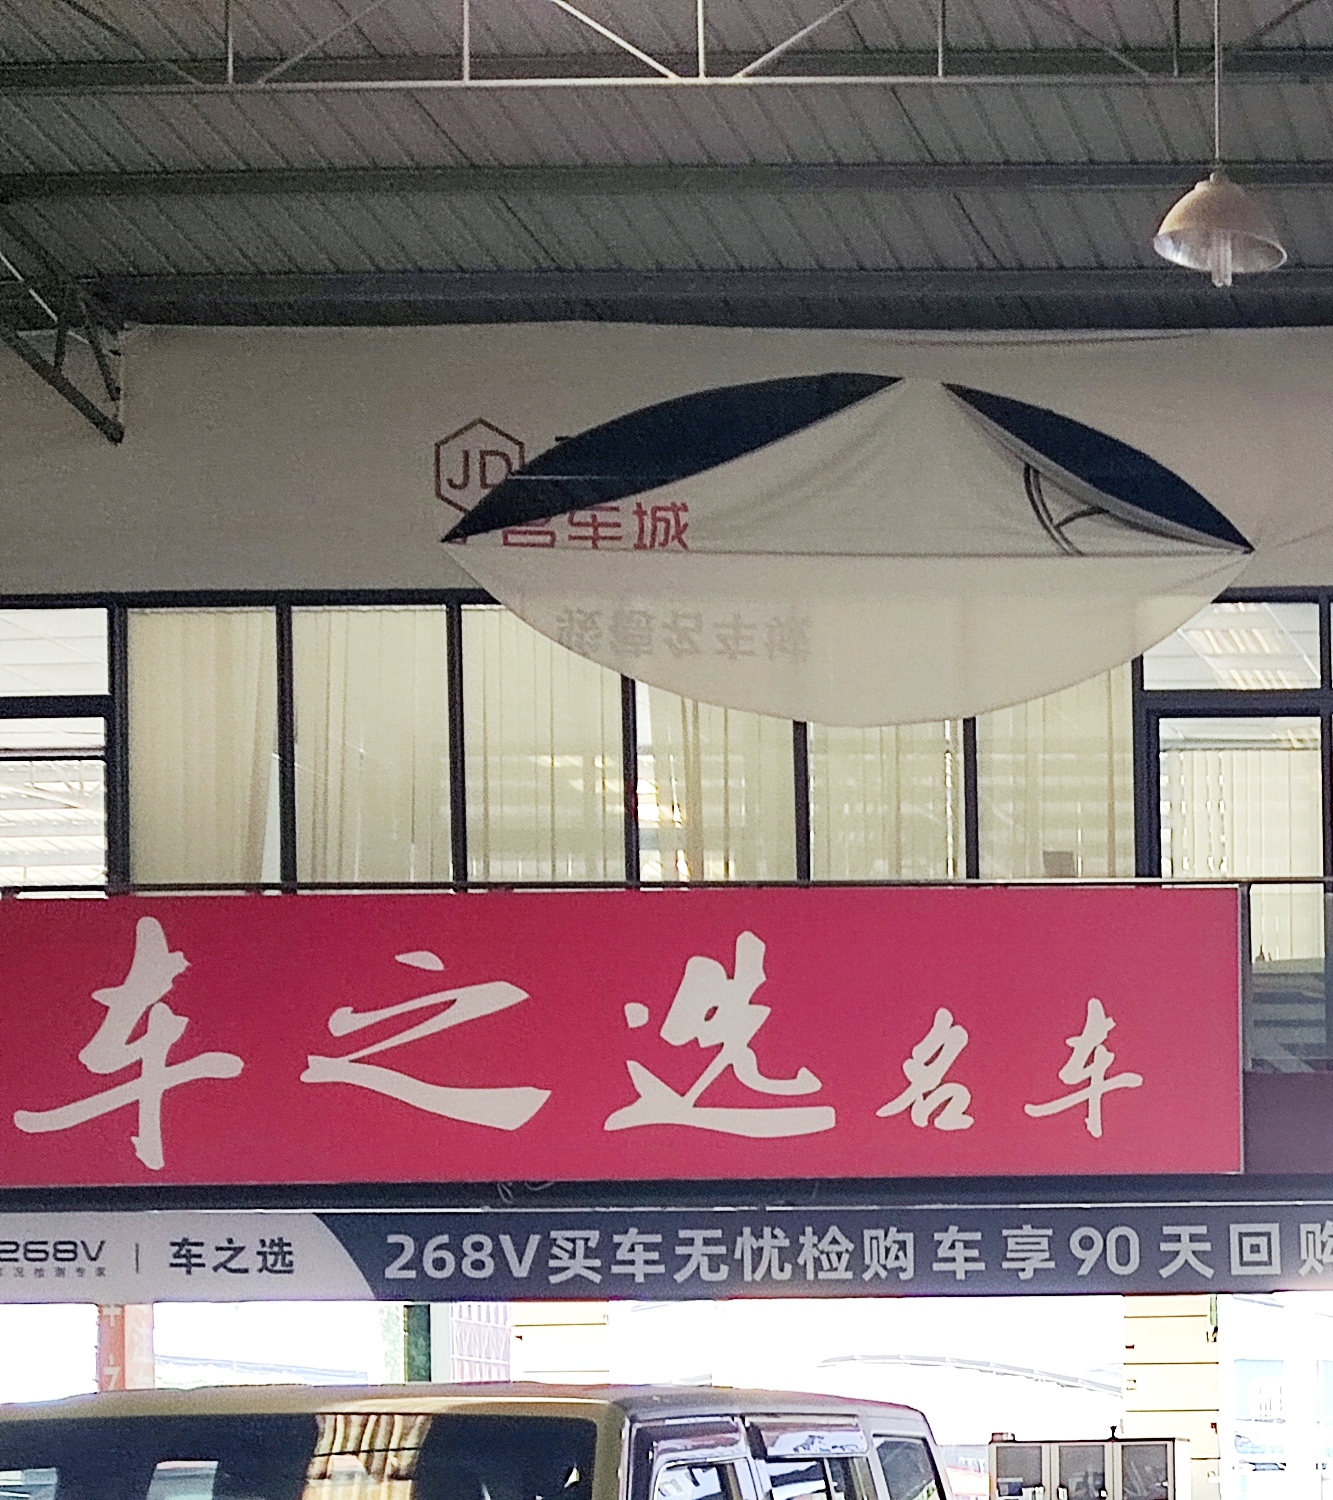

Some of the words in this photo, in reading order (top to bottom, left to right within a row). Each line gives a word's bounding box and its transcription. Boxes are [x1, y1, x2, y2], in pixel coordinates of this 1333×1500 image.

[0, 1241, 106, 1262] 268V
[167, 1236, 296, 1275] 车之选
